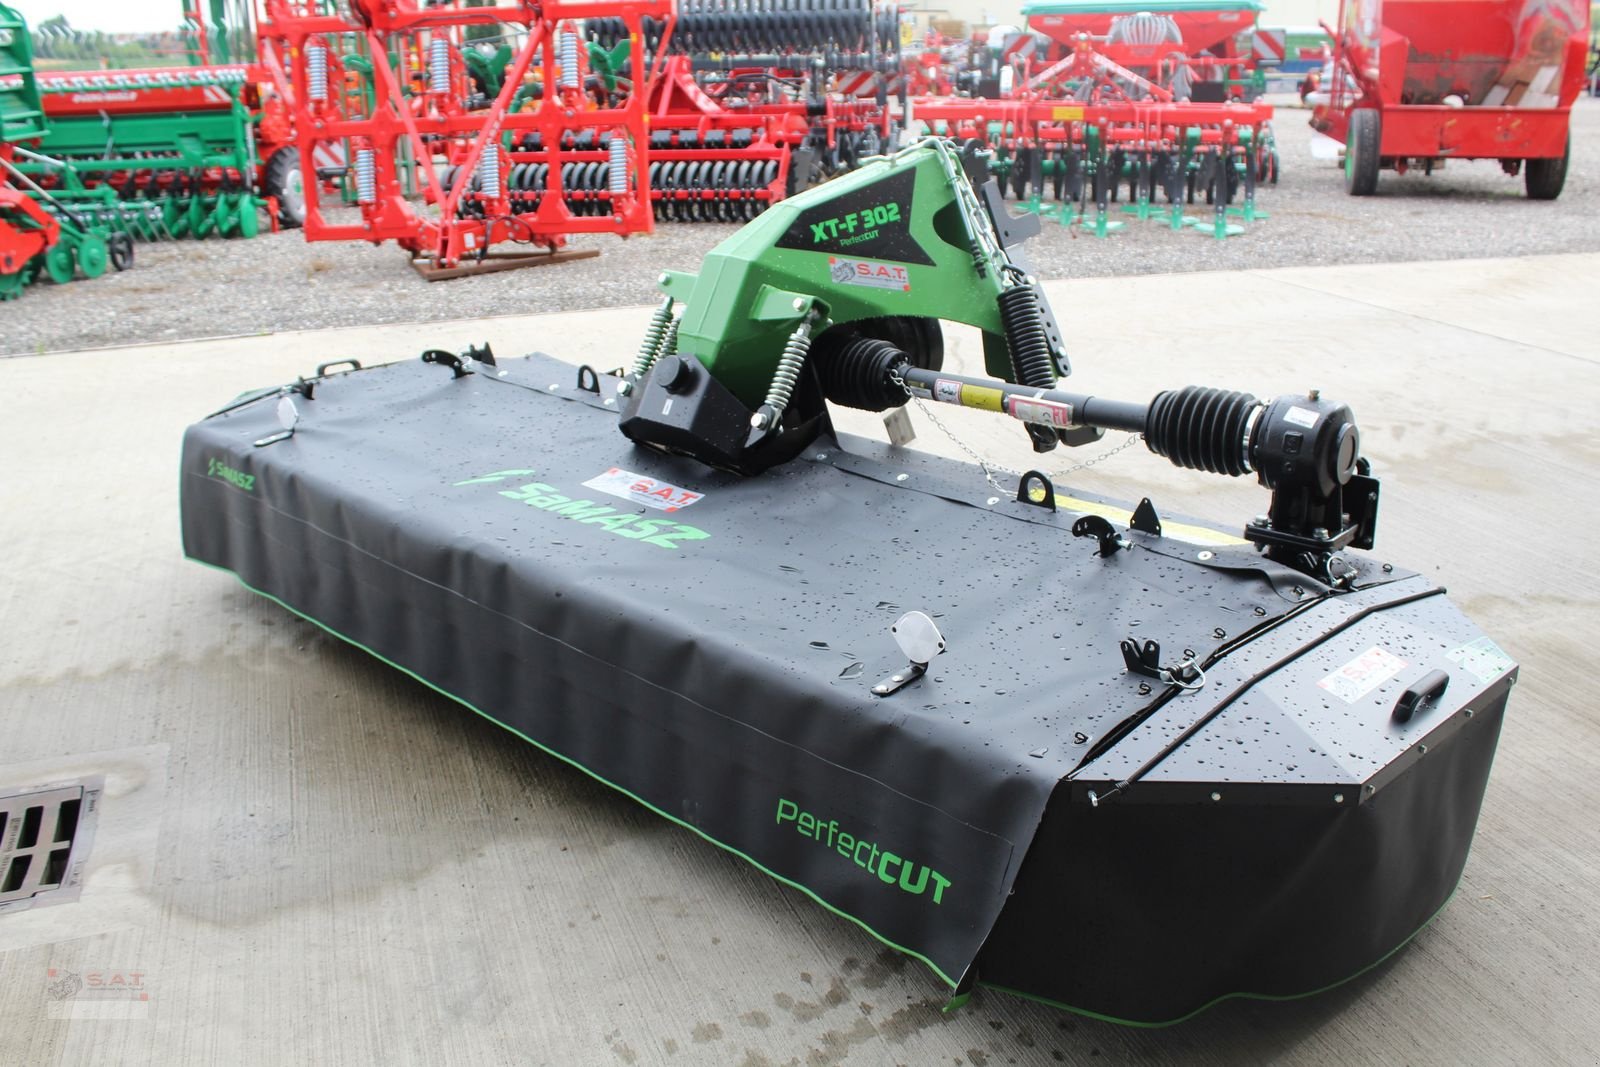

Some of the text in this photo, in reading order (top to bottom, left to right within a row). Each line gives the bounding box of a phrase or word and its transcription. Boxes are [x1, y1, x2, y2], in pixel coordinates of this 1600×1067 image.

[810, 202, 901, 243] XT-F 302
[856, 262, 907, 280] S.A.T.
[776, 798, 952, 905] PerfectCUT
